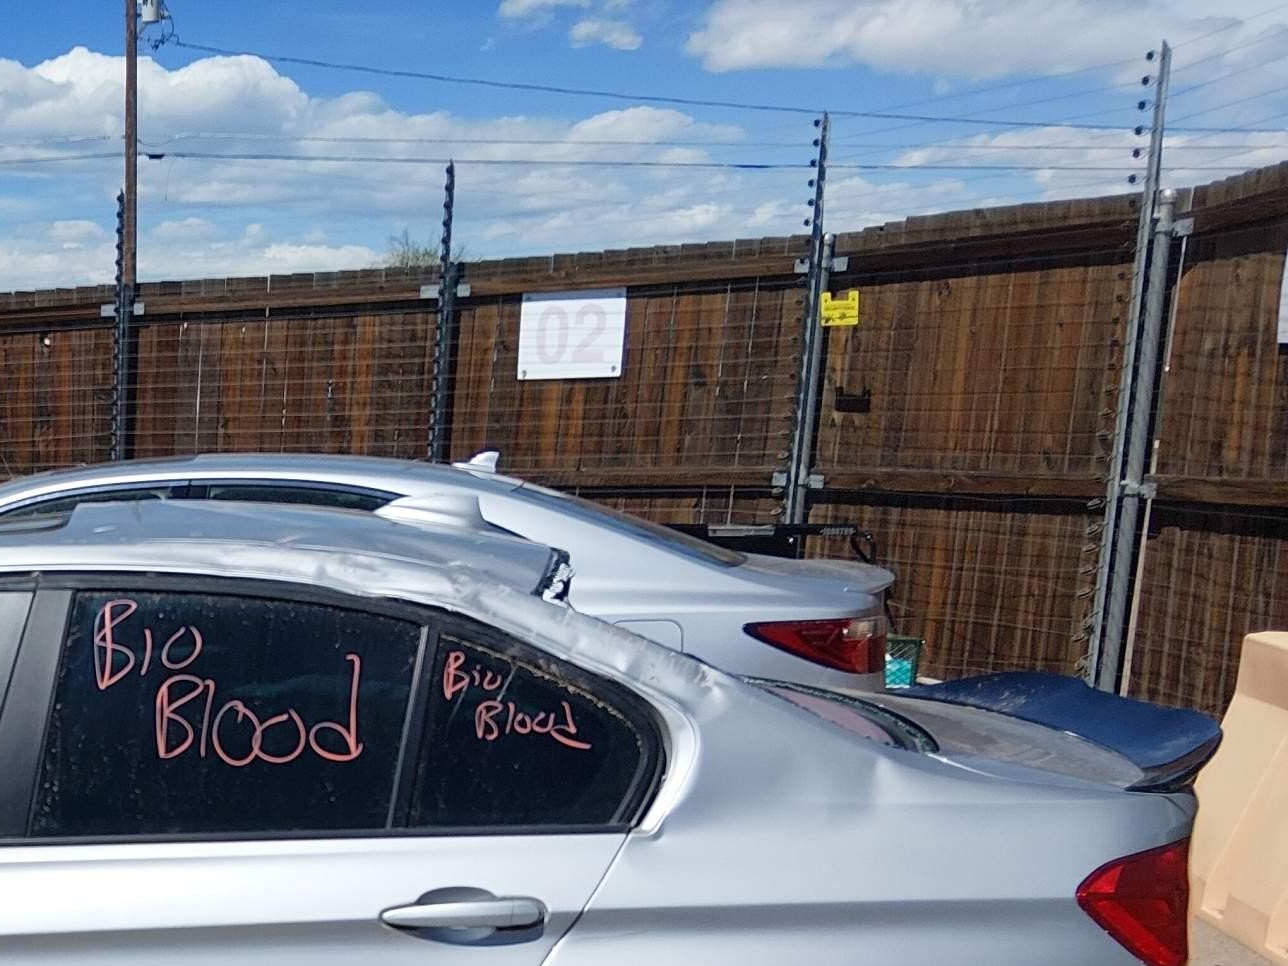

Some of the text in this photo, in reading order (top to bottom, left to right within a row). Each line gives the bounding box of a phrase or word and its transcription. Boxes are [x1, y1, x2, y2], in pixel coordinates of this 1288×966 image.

[536, 303, 607, 365] 02
[155, 653, 364, 767] Blood
[474, 701, 592, 750] Blood
